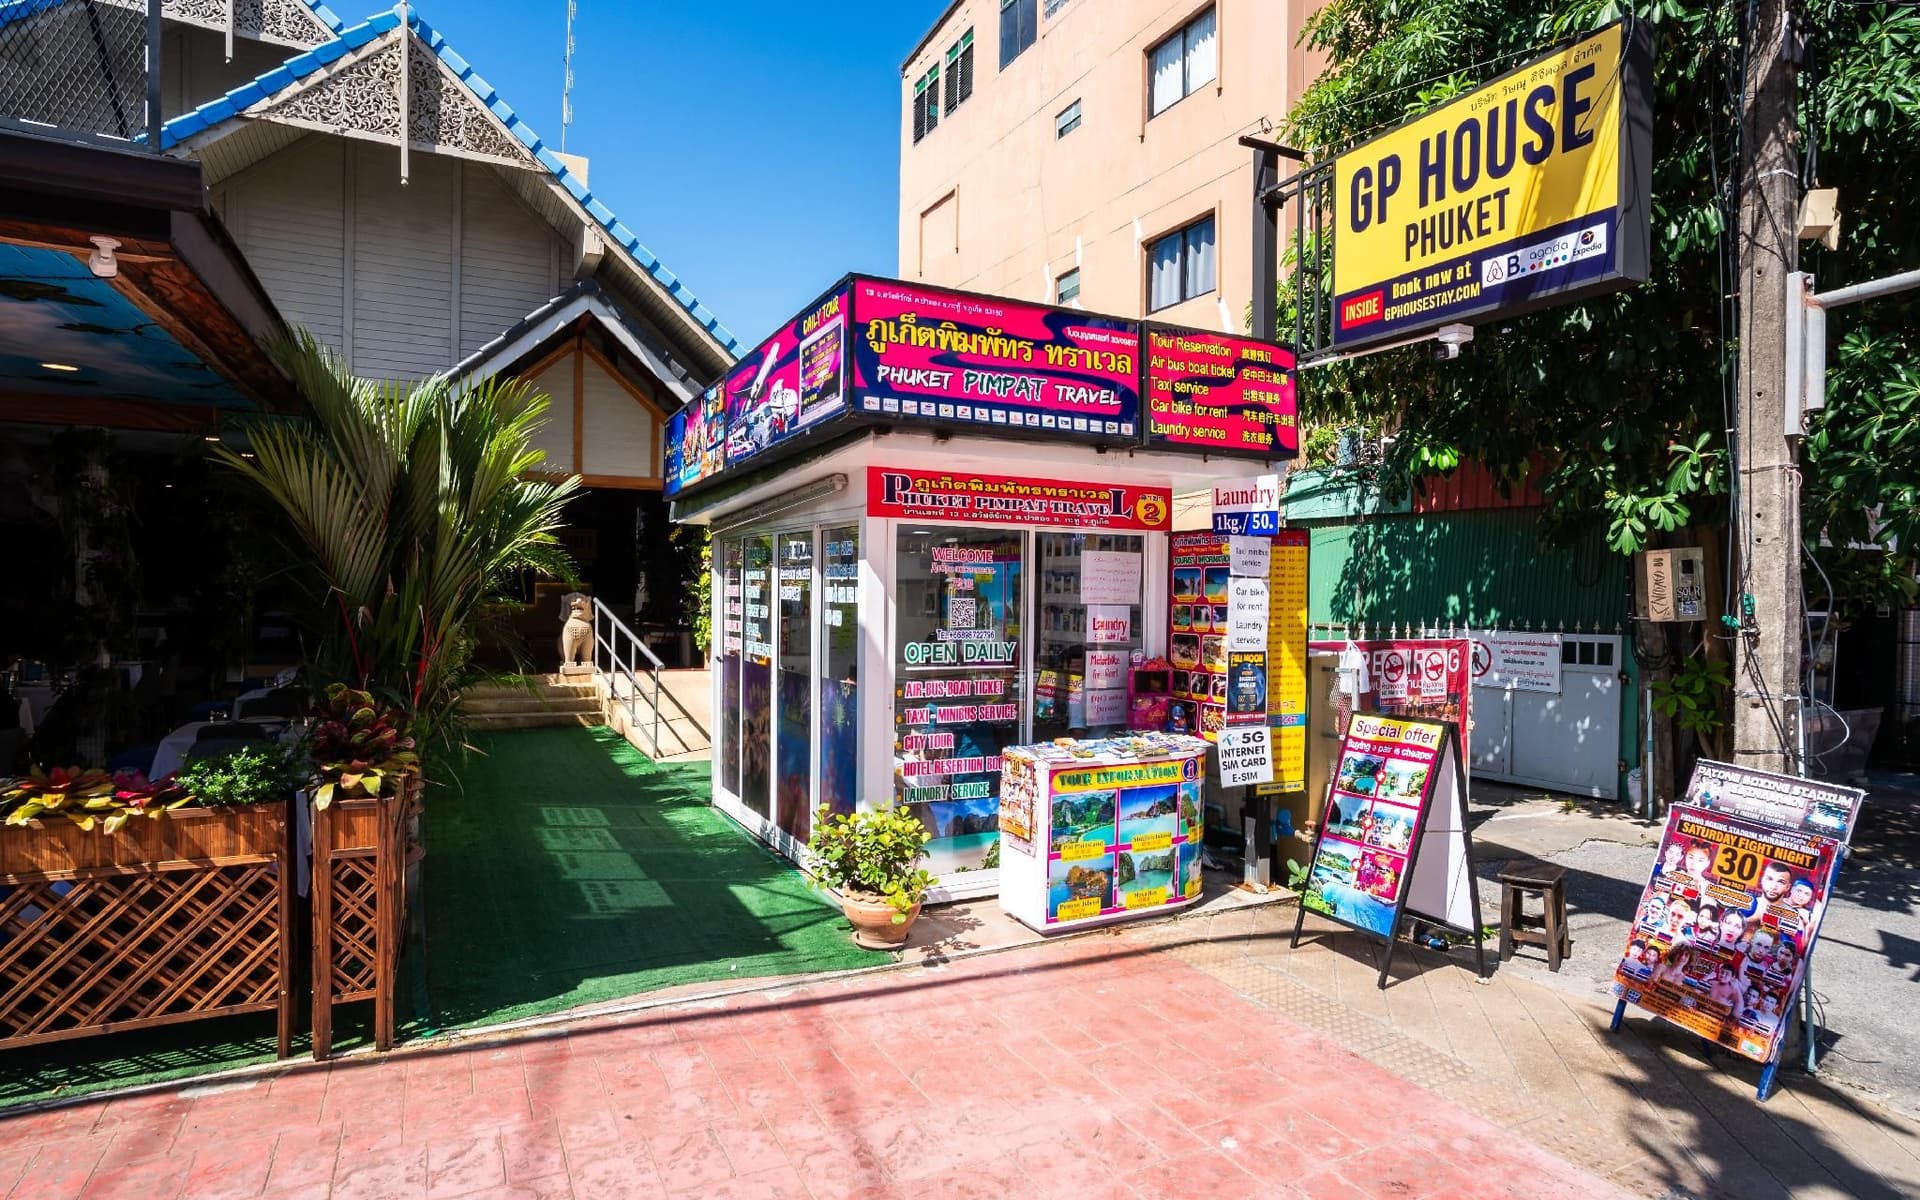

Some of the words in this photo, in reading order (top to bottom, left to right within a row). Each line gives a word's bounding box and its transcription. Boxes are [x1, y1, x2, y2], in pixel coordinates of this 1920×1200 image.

[1350, 154, 1401, 233] GP
[1419, 63, 1595, 208] HOUSE
[1405, 188, 1511, 262] PHUKET
[1529, 241, 1569, 261] agoda
[1572, 241, 1603, 258] Expedia
[1392, 275, 1421, 299] Book
[1425, 269, 1452, 290] now
[1456, 260, 1472, 280] at
[1345, 297, 1379, 322] INSIDE
[1384, 282, 1480, 322] GPHOUSESTAY.COM
[803, 309, 822, 335] DAILY
[822, 296, 839, 323] TOUR
[866, 312, 1034, 362] ภูเก็ตพิมพัทร
[1045, 344, 1132, 375] ทราเวล
[1150, 332, 1174, 349] Tour
[1176, 337, 1232, 357] Reservation
[1150, 355, 1165, 369] Air
[1167, 357, 1186, 371] bus
[1188, 360, 1209, 374] boat
[1211, 363, 1236, 379] ticket
[877, 365, 953, 390] PHUKET
[963, 369, 1046, 402] PIMPAT
[1054, 384, 1122, 406] TRAVEL
[1151, 376, 1172, 392] Taxi
[1174, 381, 1209, 395] service
[1150, 399, 1168, 412] Car
[1171, 400, 1192, 415] bike
[1194, 402, 1206, 416] for
[1209, 406, 1228, 419] rent
[1150, 419, 1190, 439] Laundry
[1193, 426, 1226, 440] service
[882, 472, 971, 509] PHUKET
[975, 495, 1047, 513] PIMPAT
[1050, 488, 1133, 520] TRAVEL
[1215, 484, 1275, 509] Laundry
[1144, 502, 1162, 523] 2
[1252, 513, 1274, 530] 50.
[931, 547, 994, 563] WELCOME
[1236, 587, 1247, 596] Car
[1250, 587, 1264, 596] bike
[1236, 602, 1245, 610] for
[1093, 617, 1127, 635] Laundry
[1236, 620, 1263, 632] Laundry
[1236, 636, 1261, 645] service
[905, 642, 957, 664] OPEN
[963, 641, 1017, 663] DAILY
[974, 679, 1005, 696] TICKET
[905, 708, 930, 725] TAXI
[936, 706, 977, 724] MINIBUS
[979, 704, 1016, 721] SERVICE
[904, 734, 927, 751] CITY
[928, 733, 954, 749] TOUR
[1242, 731, 1264, 744] 5G
[1355, 719, 1402, 738] Special
[1404, 726, 1437, 744] offer
[1221, 745, 1266, 760] INTERNET
[1347, 740, 1371, 753] Buying
[1377, 744, 1392, 755] pair
[1394, 747, 1400, 755] is
[1401, 748, 1434, 761] cheaper
[903, 760, 932, 777] HOTEL
[934, 757, 984, 774] RESERTION
[1222, 760, 1240, 771] SIM
[1241, 757, 1267, 769] CARD
[1058, 773, 1092, 787] TOUR
[1096, 765, 1179, 784] INFORMATION
[1232, 771, 1258, 783] E-SIM
[904, 785, 950, 803] LAUNDRY
[951, 782, 989, 800] SERVICE
[1697, 767, 1742, 784] PATONG
[1742, 775, 1790, 795] BOXING
[1791, 784, 1854, 807] STADIUM
[1680, 812, 1704, 825] PATONG
[1705, 819, 1728, 832] BOXING
[1728, 825, 1758, 841] STADIUM
[1681, 822, 1738, 846] SATURDAY
[1737, 836, 1772, 856] FIGHT
[1773, 845, 1815, 869] NIGHT
[1717, 847, 1758, 881] 30
